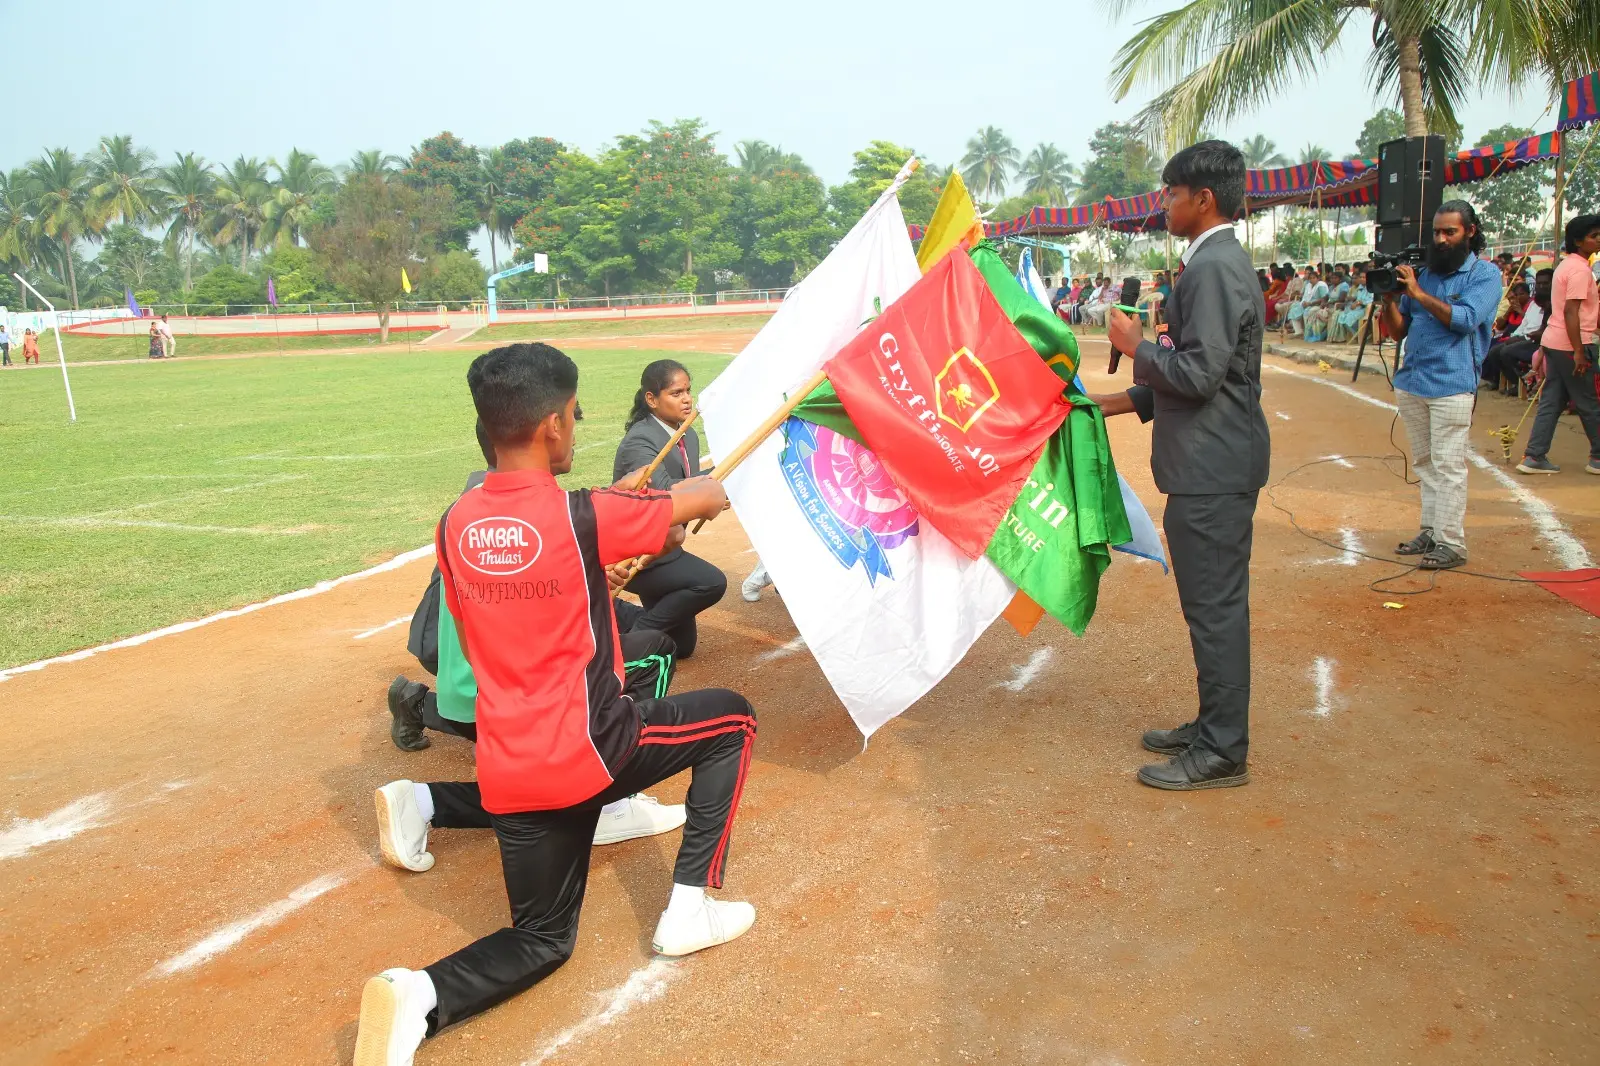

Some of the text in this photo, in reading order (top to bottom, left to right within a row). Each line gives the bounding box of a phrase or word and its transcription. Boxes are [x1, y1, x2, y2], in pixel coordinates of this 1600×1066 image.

[785, 461, 846, 550] A Vision for Success
[467, 525, 529, 549] AMBAL
[477, 548, 524, 566] Thulasi
